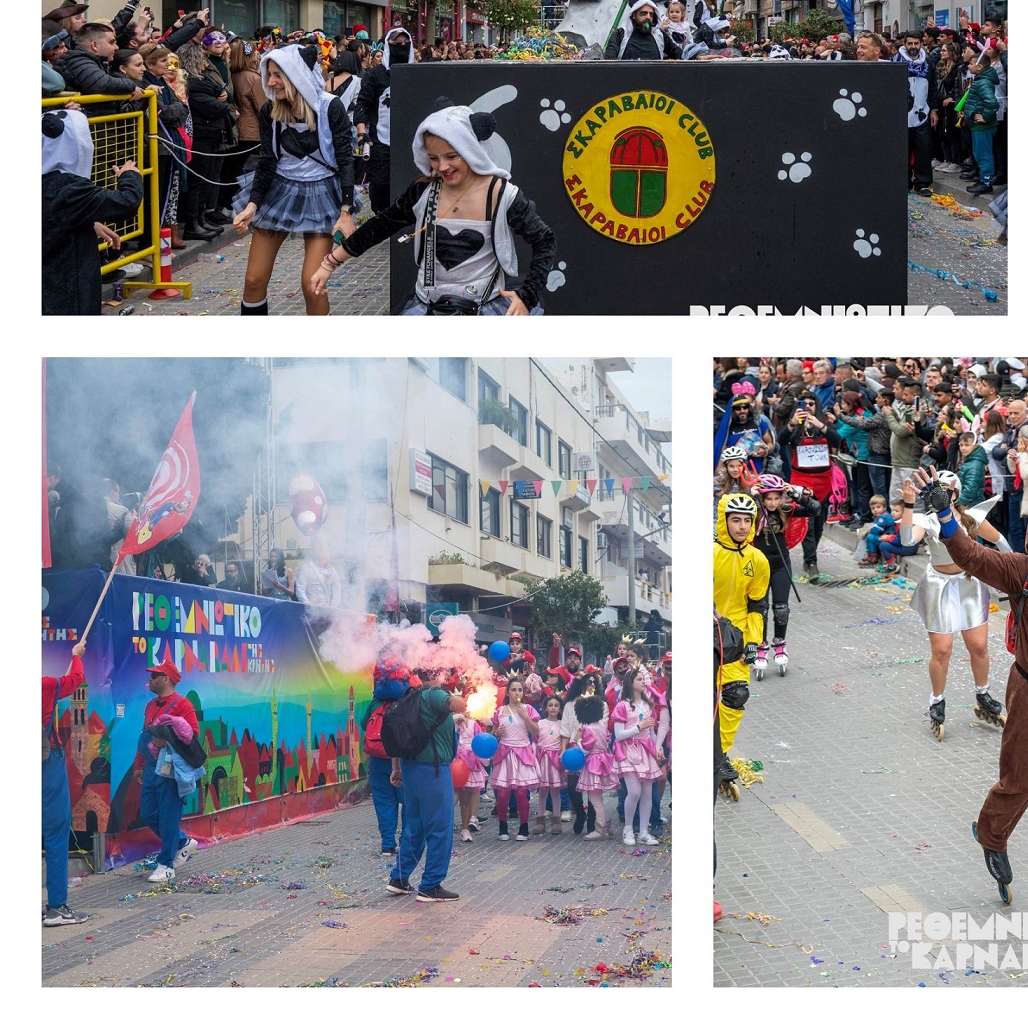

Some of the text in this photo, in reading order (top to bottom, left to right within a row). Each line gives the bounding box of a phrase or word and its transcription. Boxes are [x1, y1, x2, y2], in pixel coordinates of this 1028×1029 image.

[567, 92, 715, 161] ΣΚΑΡΑΒΑΙΟΙ CLUB
[565, 173, 716, 244] ΣΚΑΡΑΒΑΙΟΙ CLUB
